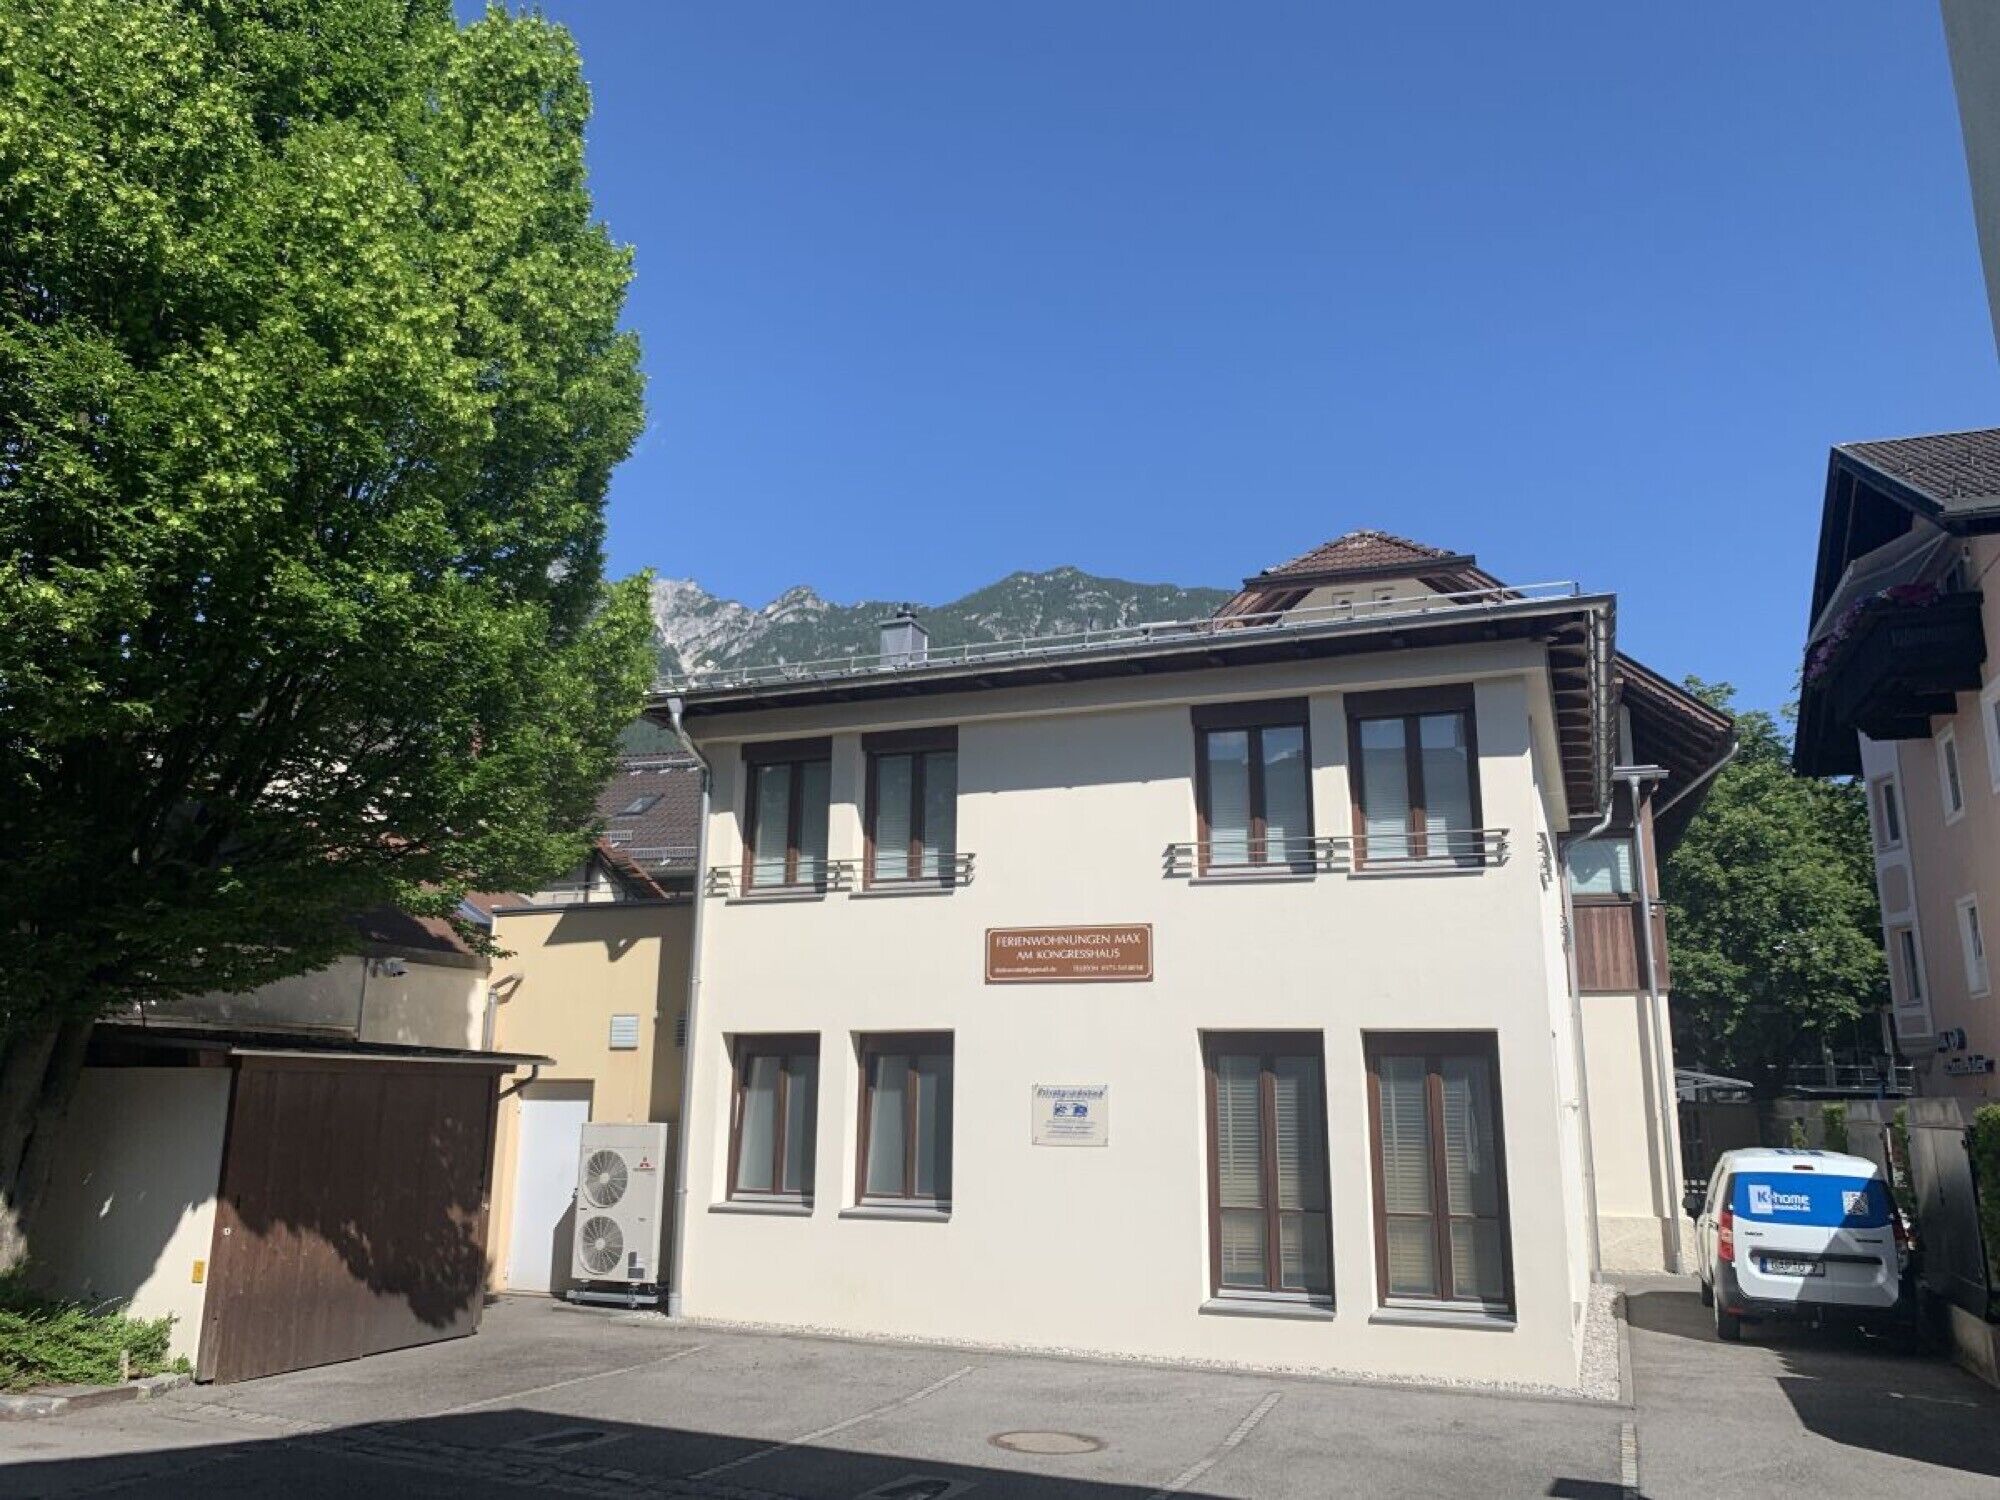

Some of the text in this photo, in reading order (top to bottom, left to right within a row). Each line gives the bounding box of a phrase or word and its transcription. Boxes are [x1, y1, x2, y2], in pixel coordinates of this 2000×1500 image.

[996, 932, 1141, 948] FERIENWOHNUNGEN MAX
[1016, 947, 1121, 961] AM KONGRESSHAUS
